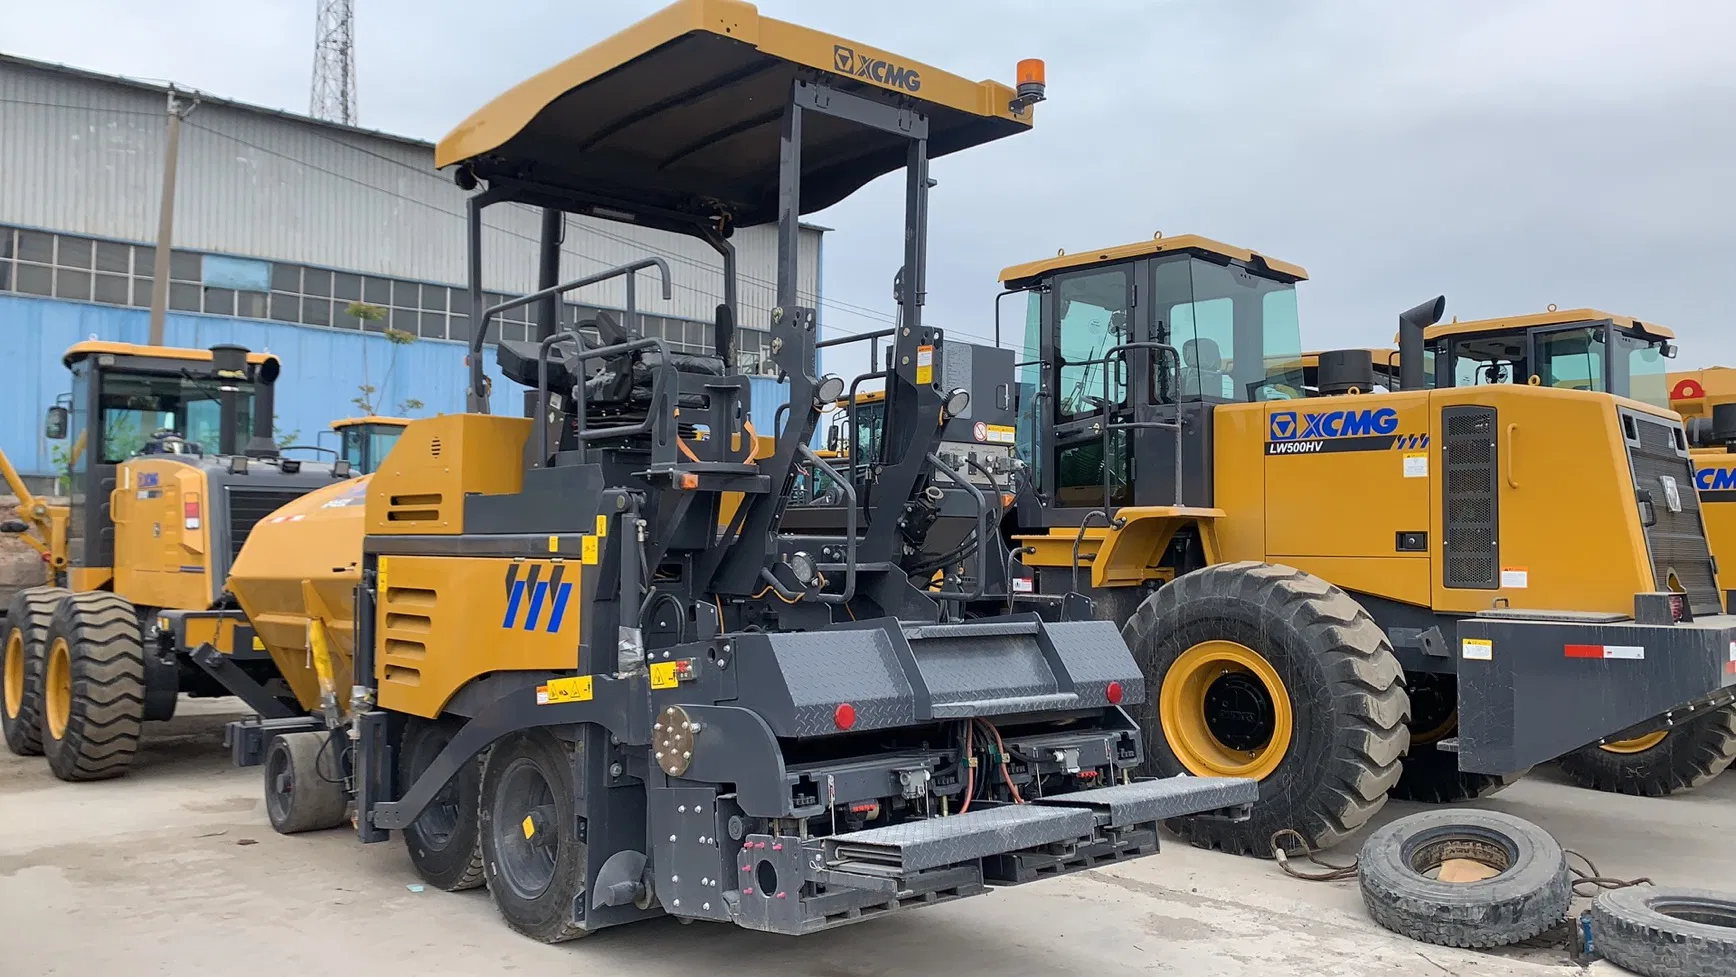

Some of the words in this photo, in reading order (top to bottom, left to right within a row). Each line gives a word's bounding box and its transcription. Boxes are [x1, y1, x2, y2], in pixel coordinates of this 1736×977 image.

[855, 54, 921, 91] XCMG
[1298, 408, 1398, 438] XCMG
[1270, 441, 1323, 453] LW500HV
